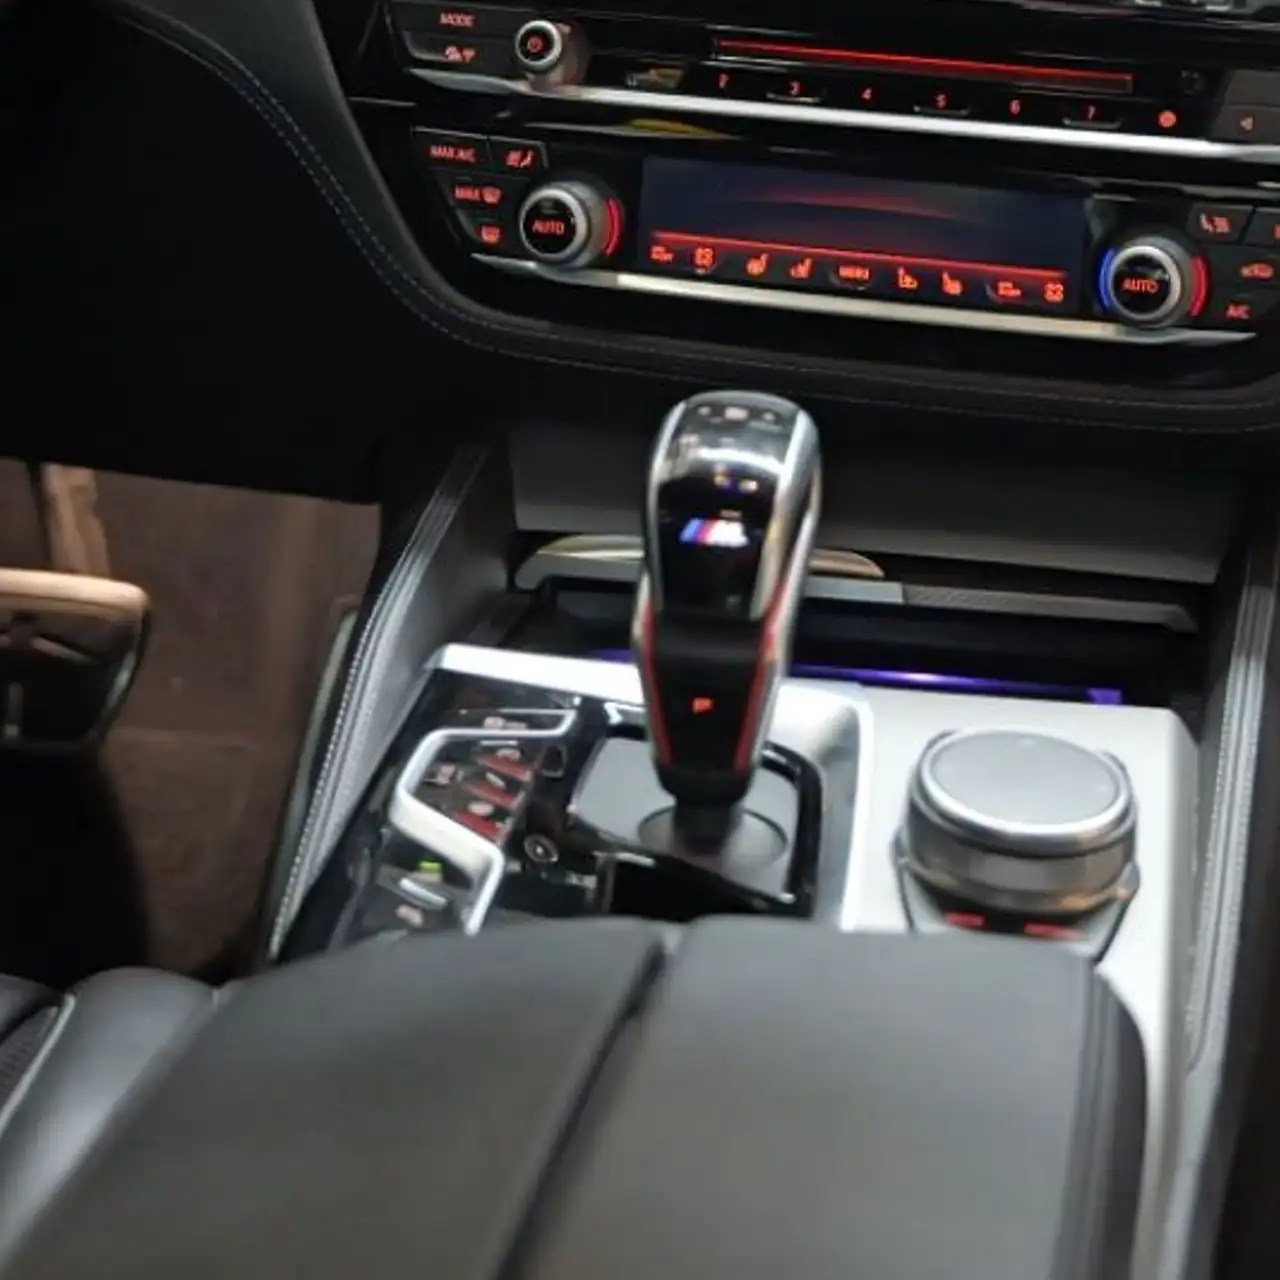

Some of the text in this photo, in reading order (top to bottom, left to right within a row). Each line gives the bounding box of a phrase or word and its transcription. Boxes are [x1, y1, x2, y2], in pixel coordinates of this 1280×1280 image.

[790, 80, 800, 96] 3
[860, 87, 872, 101] 4
[532, 220, 564, 236] AUTO
[1122, 278, 1160, 294] AUTO
